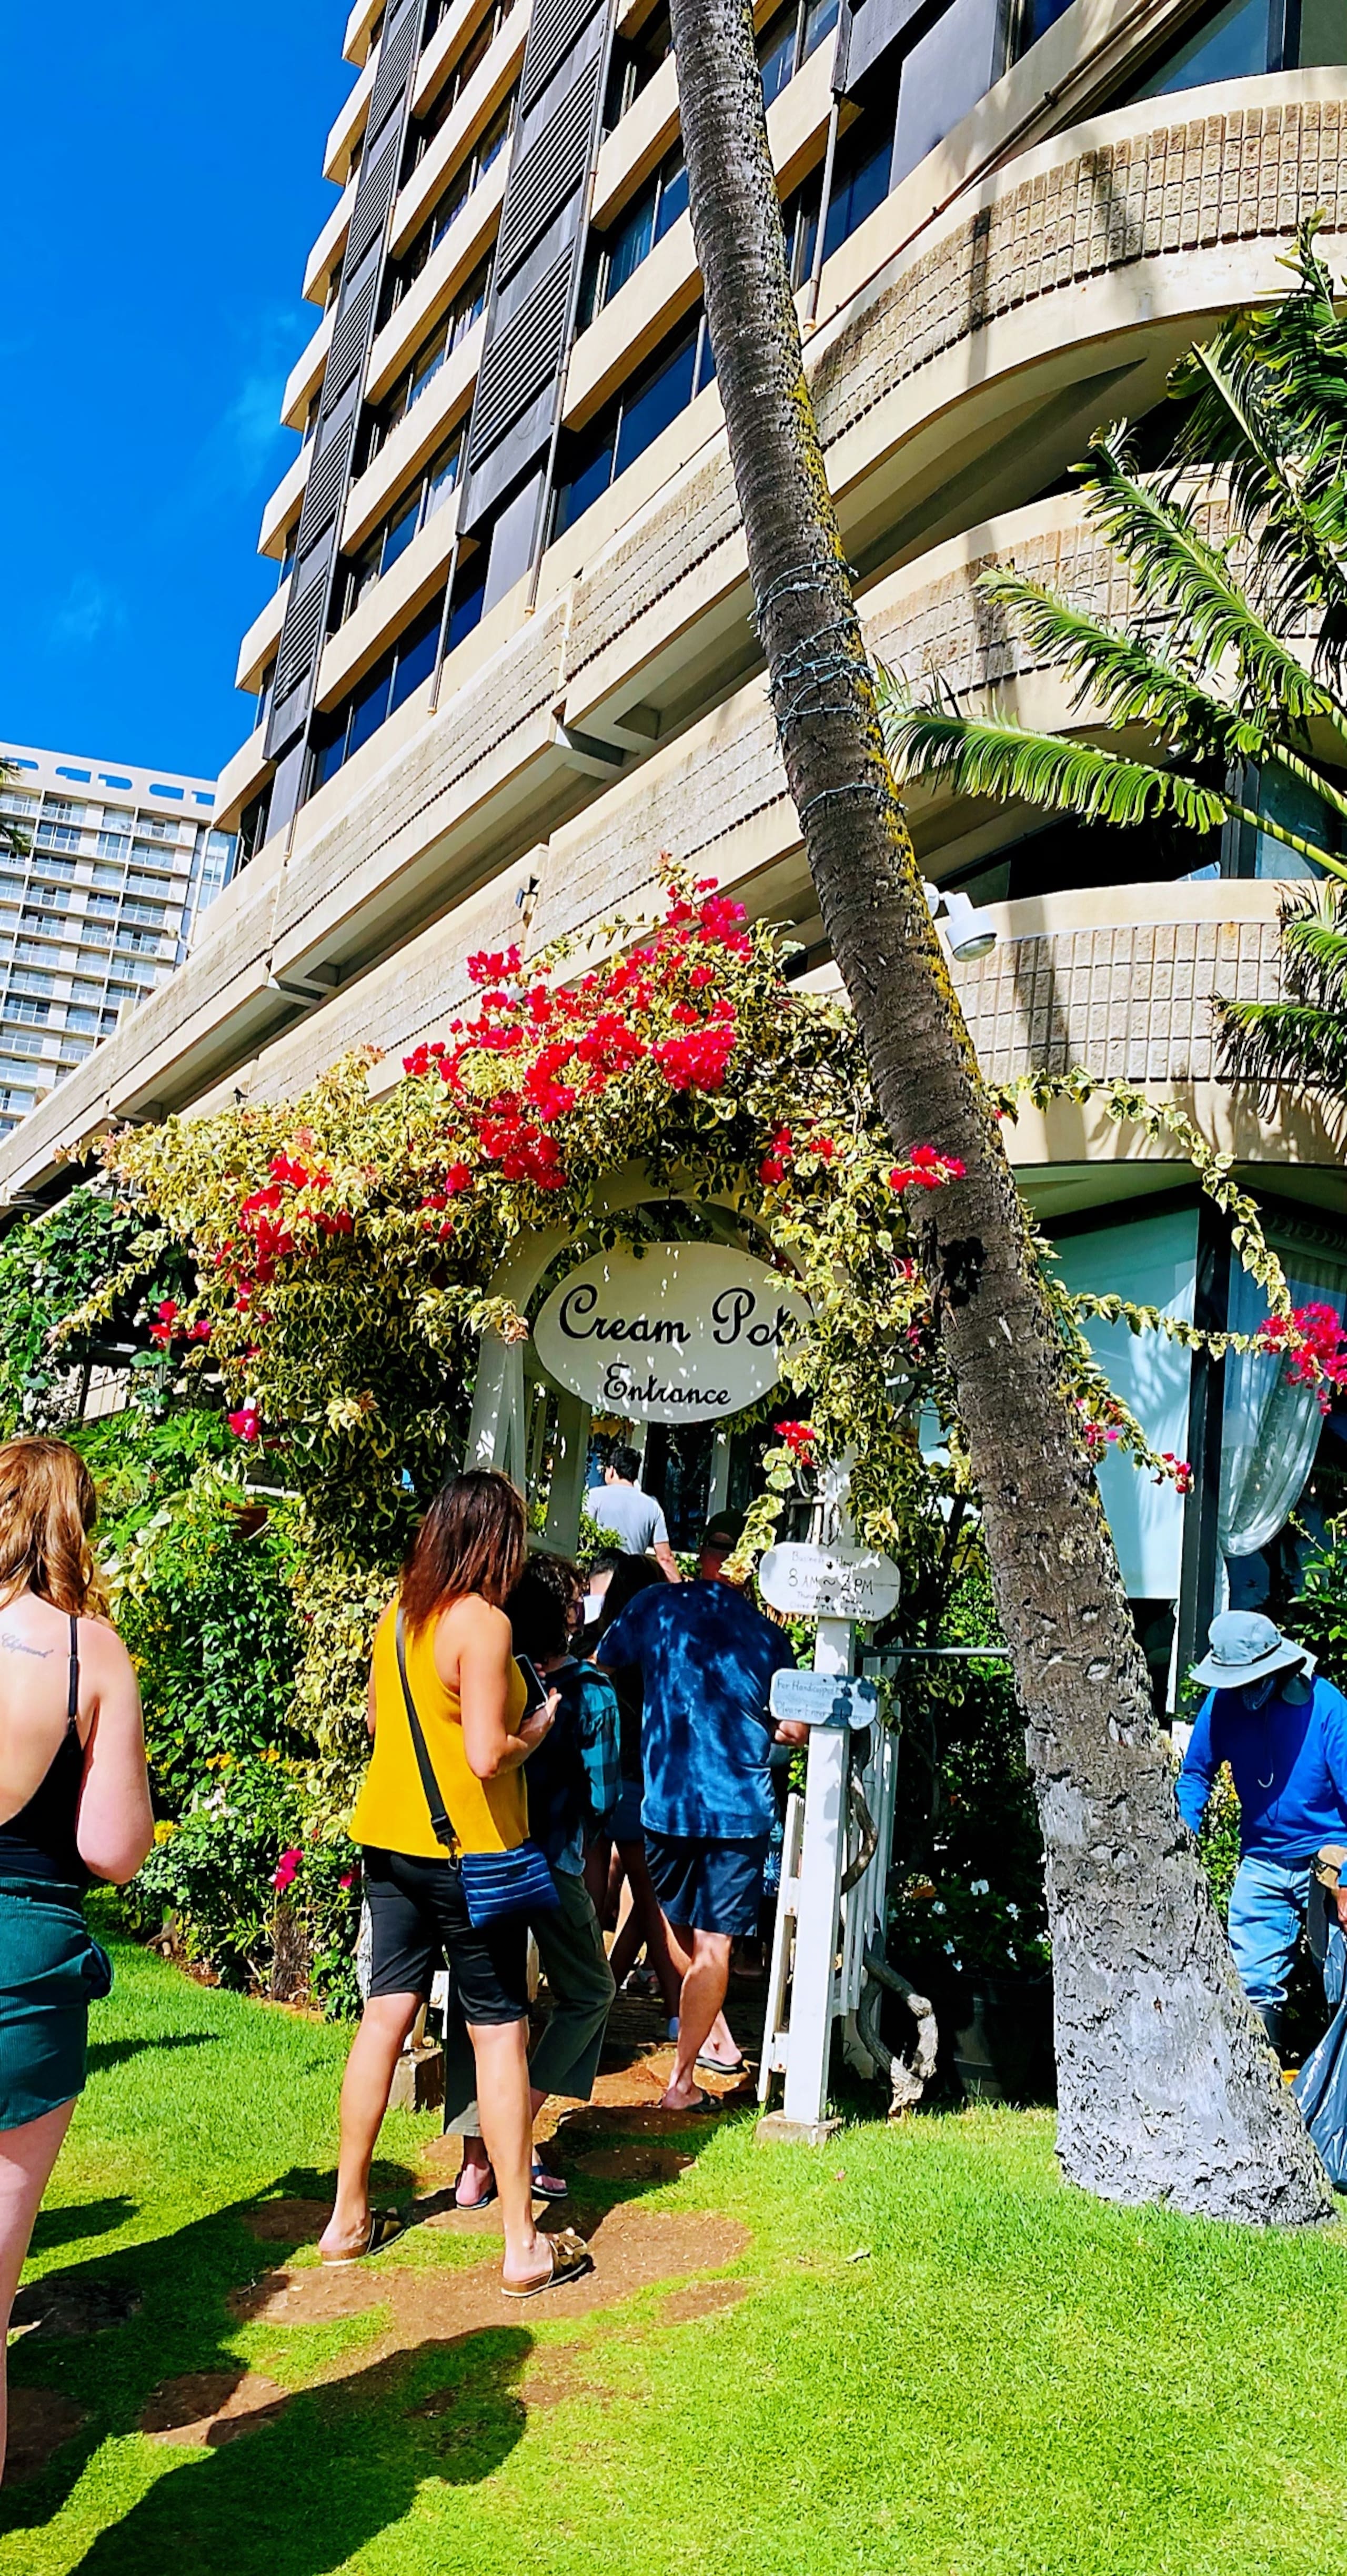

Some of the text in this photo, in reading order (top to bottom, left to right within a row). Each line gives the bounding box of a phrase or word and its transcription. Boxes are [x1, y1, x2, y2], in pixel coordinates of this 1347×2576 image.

[559, 1284, 796, 1347] Cream Pot
[604, 1362, 731, 1405] Entrance
[789, 1568, 798, 1587] 8
[803, 1576, 819, 1589] AM
[841, 1574, 850, 1592] 2
[855, 1579, 873, 1595] PM
